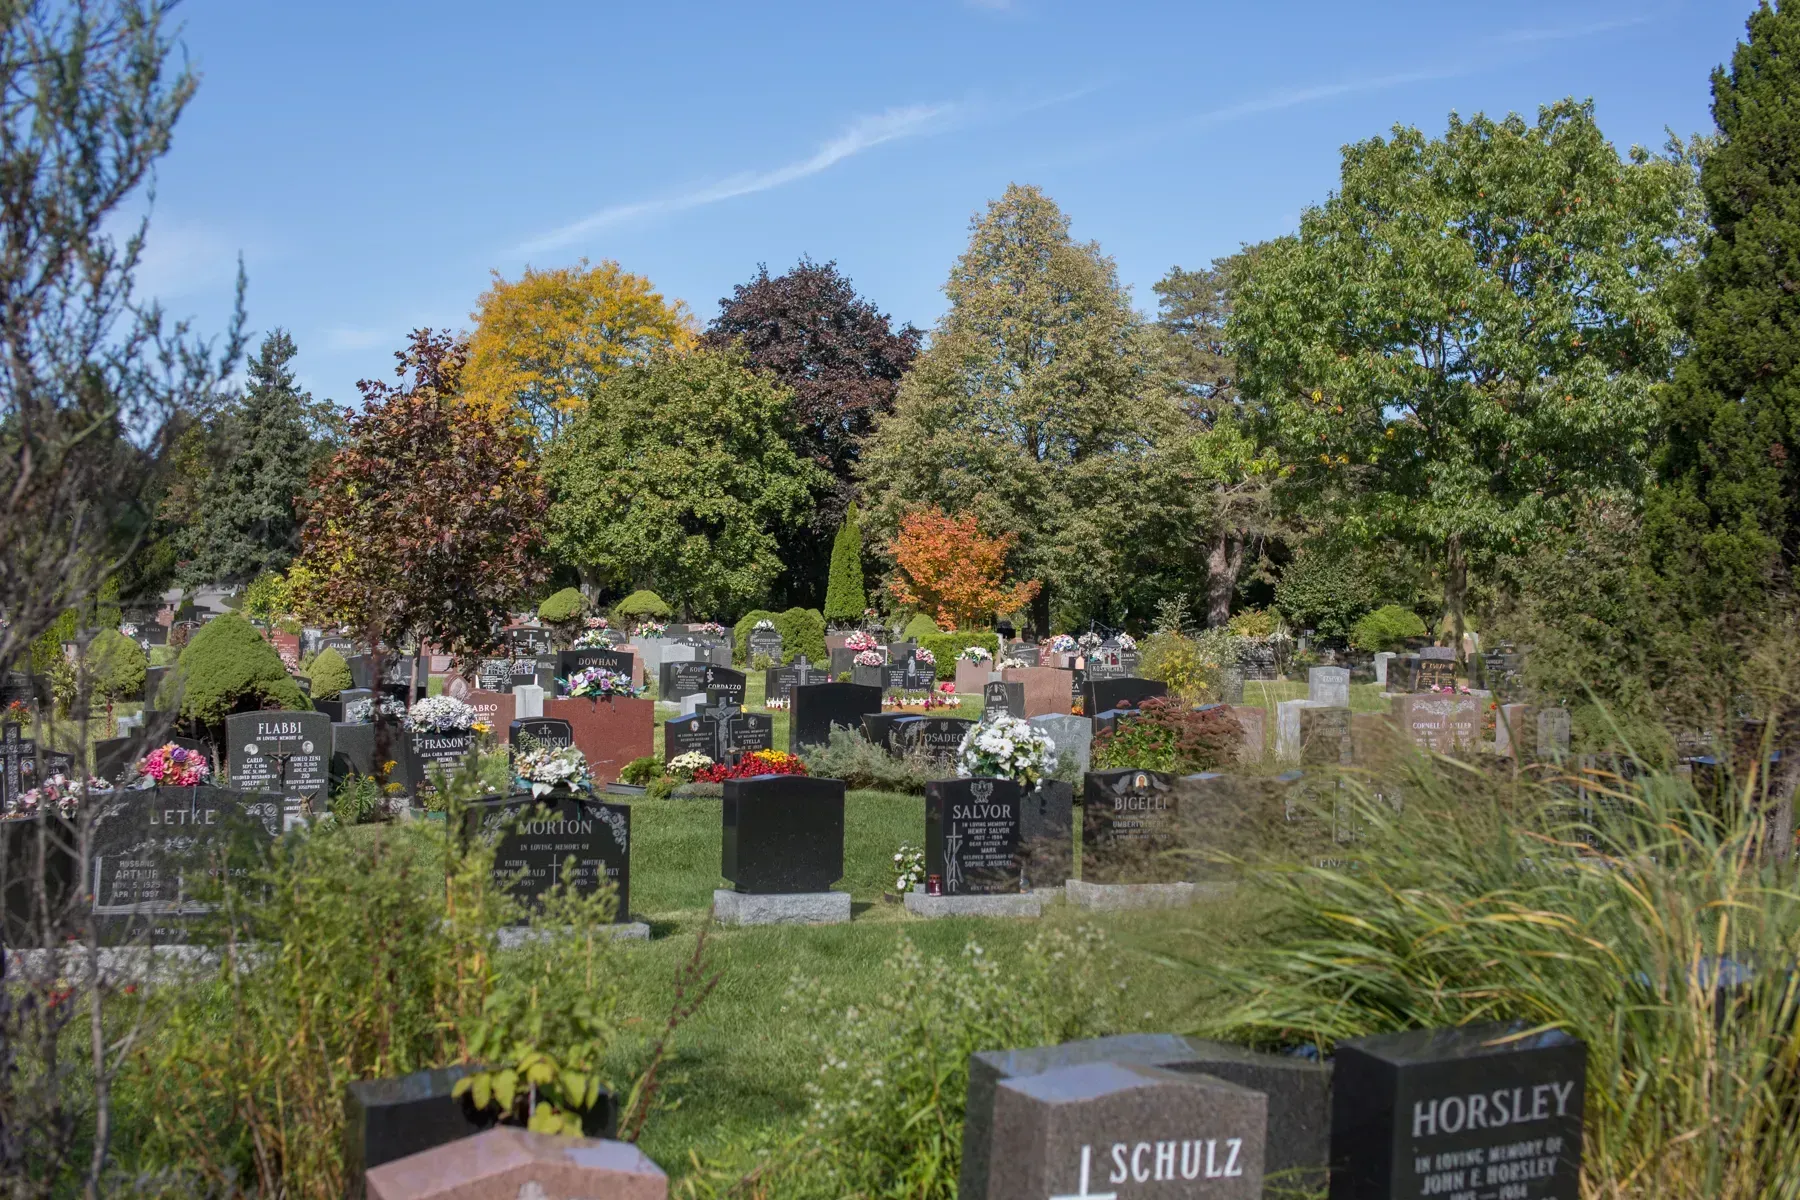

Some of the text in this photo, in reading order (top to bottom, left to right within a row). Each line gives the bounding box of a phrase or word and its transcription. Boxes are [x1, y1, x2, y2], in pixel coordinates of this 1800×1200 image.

[579, 658, 618, 666] DOWHAN
[471, 704, 498, 712] ABRO
[258, 722, 302, 735] FLABBI
[425, 738, 464, 749] FRASSON
[1114, 796, 1166, 810] BIGELLI
[953, 804, 1012, 819] SALVOR
[518, 820, 592, 834] MORTON
[119, 860, 155, 868] HUSBAND
[115, 870, 158, 880] ARTHUR
[1412, 1080, 1575, 1138] HORSLEY
[1110, 1137, 1242, 1184] SCHULZ
[1415, 1136, 1564, 1174] IN LOVING MEMORY OF
[1420, 1170, 1465, 1196] JOHN
[1486, 1156, 1558, 1185] HORSLEY
